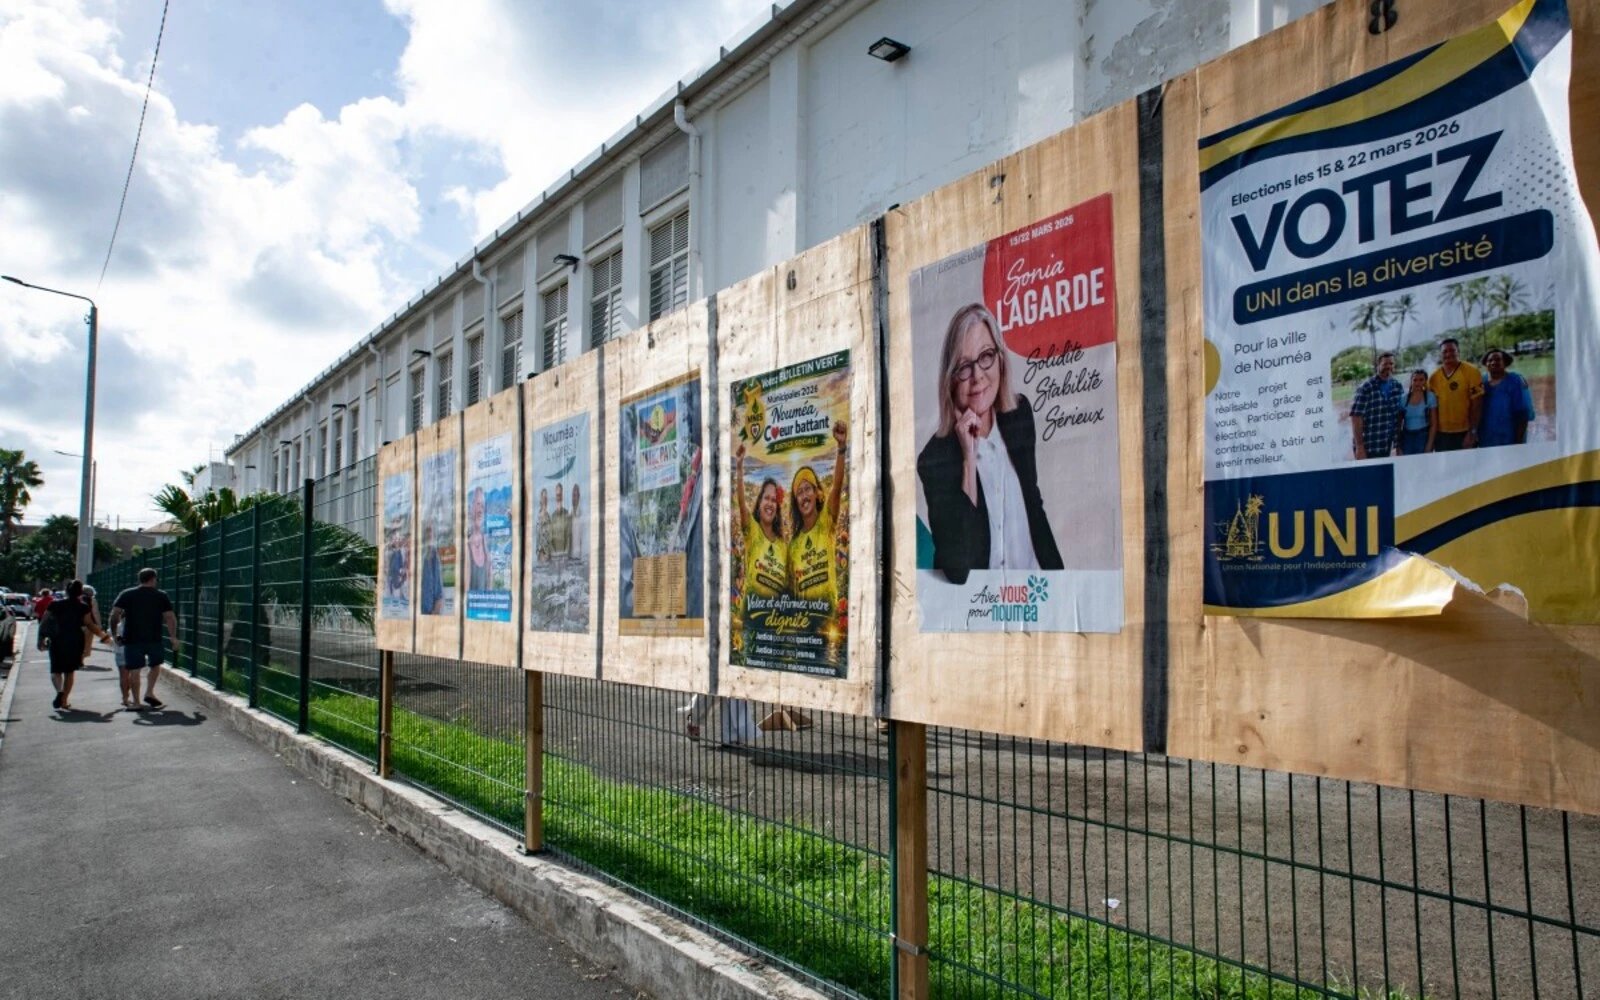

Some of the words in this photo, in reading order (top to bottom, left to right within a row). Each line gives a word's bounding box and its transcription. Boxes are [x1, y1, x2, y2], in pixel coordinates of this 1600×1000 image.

[1368, 0, 1398, 35] 8
[1231, 180, 1292, 207] Elections
[1294, 172, 1315, 186] les
[1317, 163, 1332, 178] 15
[1334, 160, 1345, 172] &
[1348, 152, 1366, 168] 22
[1370, 139, 1412, 161] mars
[1415, 120, 1460, 146] 2026
[1231, 129, 1505, 272] VOTEZ
[1010, 231, 1030, 247] 15/22
[1031, 222, 1053, 239] MARS
[1054, 214, 1074, 230] 2026
[786, 269, 797, 291] 6
[1004, 253, 1065, 306] Sonia
[1245, 288, 1281, 313] UNI
[1286, 276, 1342, 305] dans
[1348, 267, 1368, 289] la
[1373, 235, 1494, 284] diversité
[996, 267, 1105, 332] LAGARDE
[1234, 341, 1265, 356] Pour
[1267, 337, 1278, 349] la
[1281, 331, 1307, 346] ville
[780, 361, 814, 382] BULLETIN
[815, 355, 839, 370] VERT
[1024, 340, 1085, 384] Solidité
[1234, 363, 1252, 374] de
[1254, 350, 1312, 371] Nouméa
[767, 389, 801, 404] Municipales
[1033, 368, 1104, 412] Stabilité
[1215, 390, 1241, 401] Notre
[1258, 382, 1288, 396] projet
[1306, 376, 1323, 386] est
[771, 400, 819, 424] Nouméa,
[1215, 401, 1259, 414] réalisable
[1272, 395, 1302, 408] grâce
[1317, 389, 1324, 400] à
[1247, 409, 1296, 423] Participez
[1304, 405, 1324, 416] aux
[543, 423, 574, 446] Nouméa
[795, 415, 830, 433] battant
[1042, 405, 1105, 441] Sérieux
[1215, 429, 1257, 442] élections
[1312, 420, 1324, 429] et
[1215, 442, 1265, 455] contribuez
[1270, 439, 1277, 449] à
[1282, 436, 1305, 448] bâtir
[1310, 435, 1325, 444] un
[1215, 456, 1243, 469] avenir
[1268, 505, 1379, 559] UNI
[1246, 562, 1281, 571] Nationale
[1283, 562, 1302, 572] pour
[1304, 560, 1367, 571] l'Indépendance
[747, 594, 766, 611] Votez
[766, 596, 774, 608] et
[774, 594, 808, 611] affirmez
[808, 599, 830, 612] votre
[970, 585, 1000, 604] Avec
[1000, 585, 1028, 603] VOUS
[765, 609, 810, 635] dignité
[966, 607, 993, 627] pour
